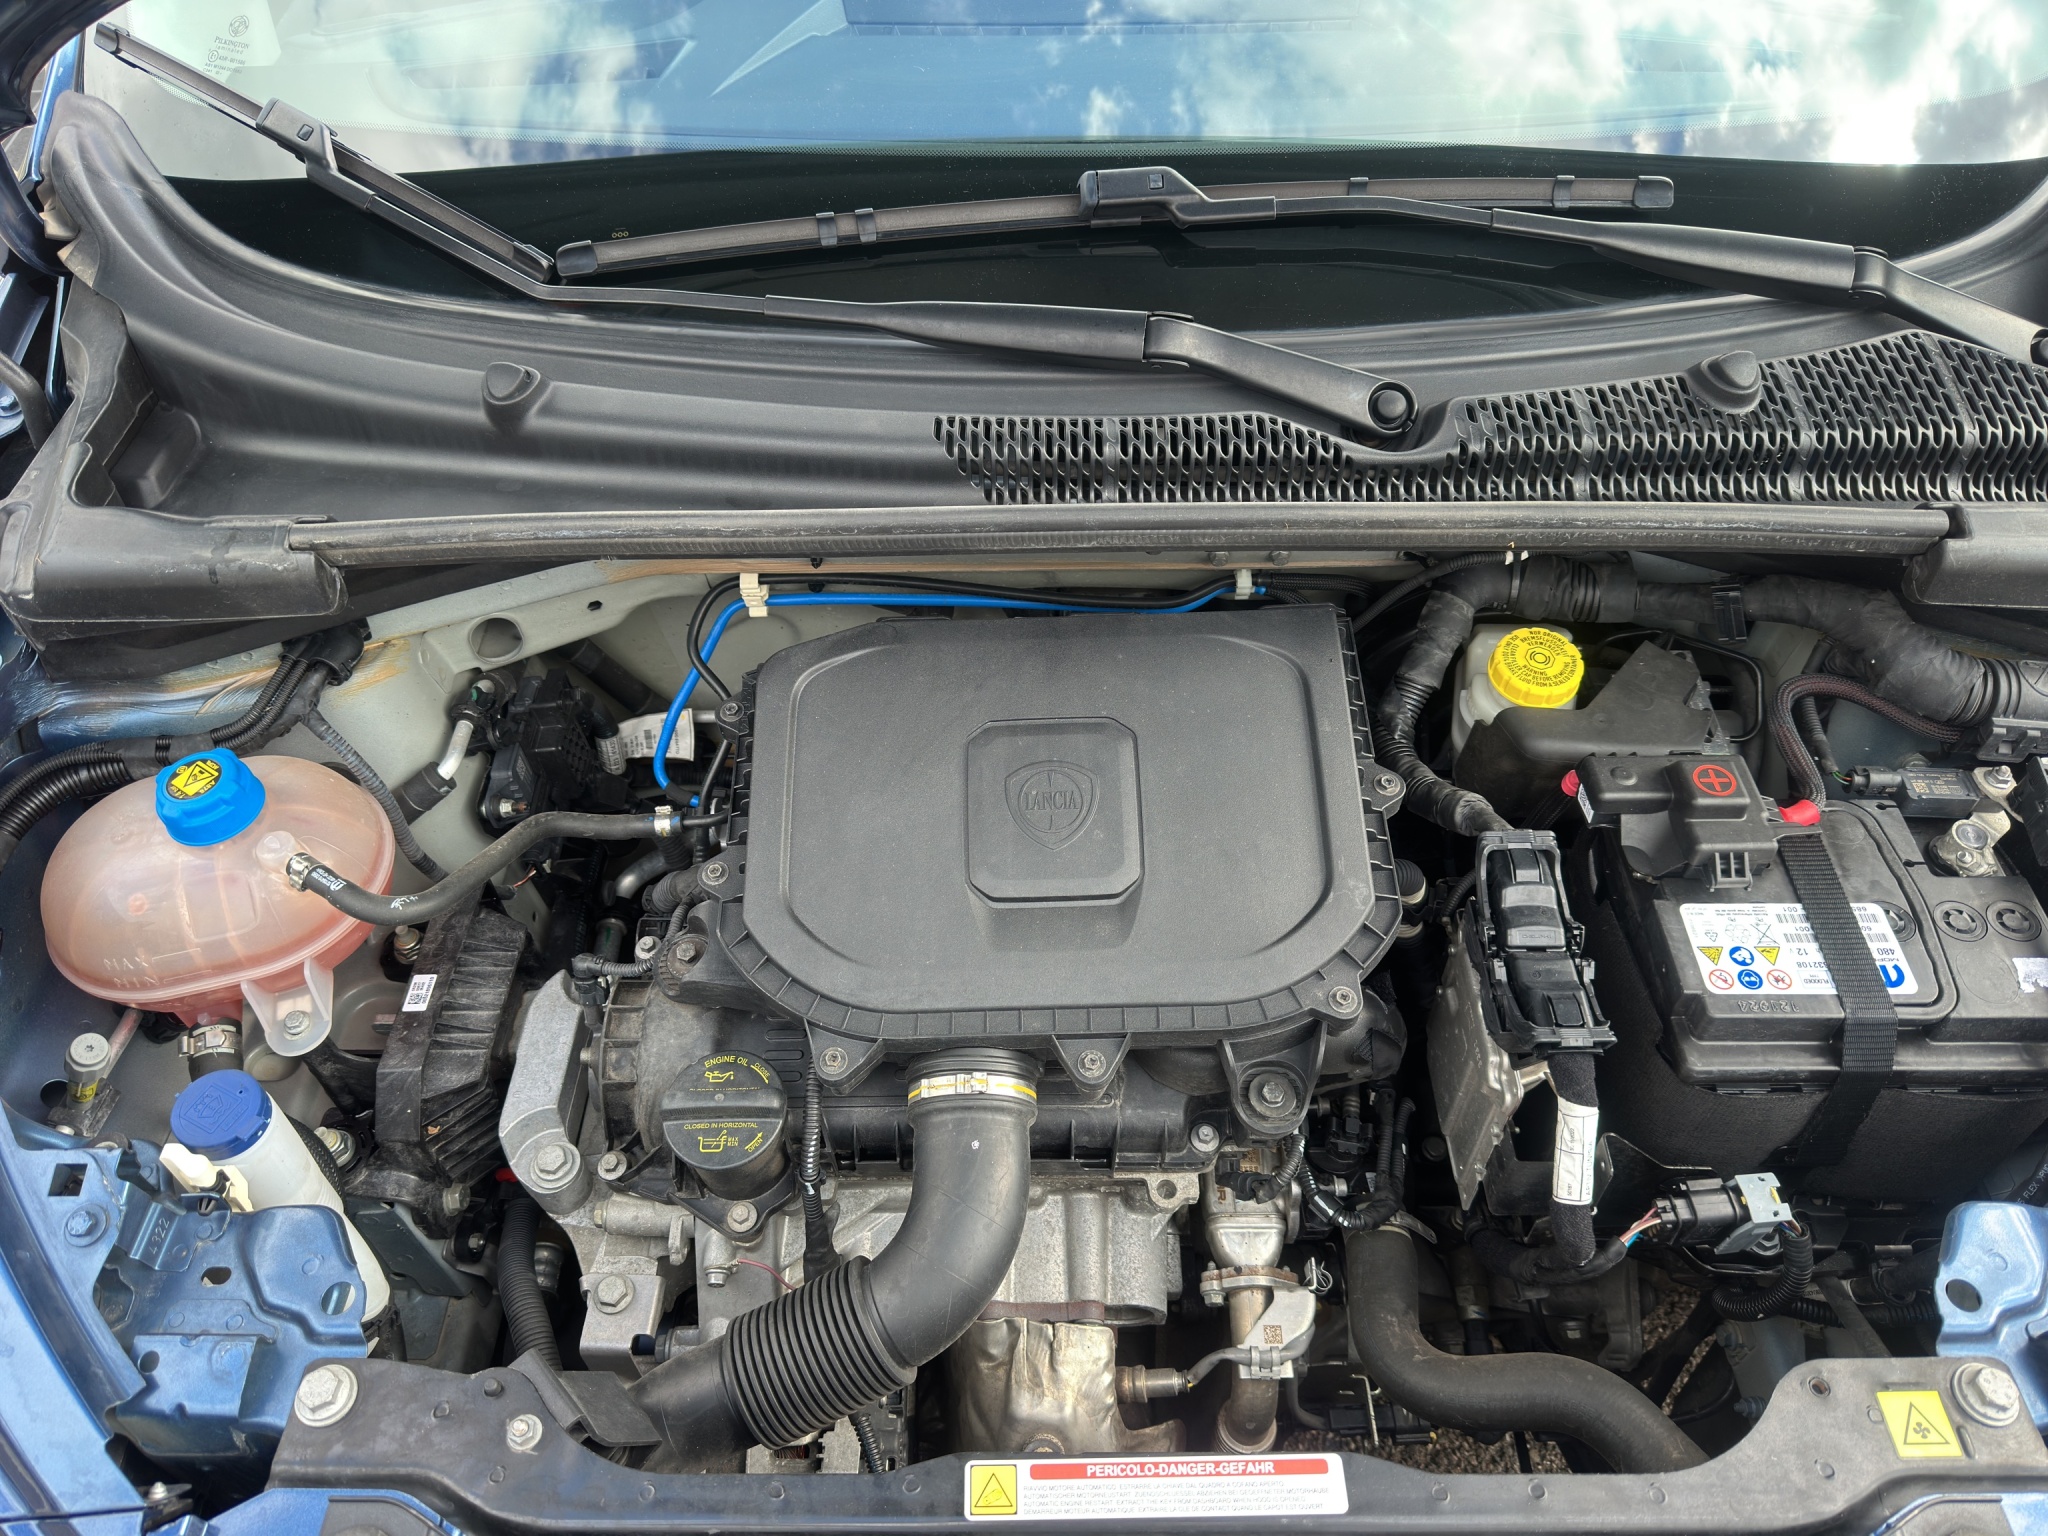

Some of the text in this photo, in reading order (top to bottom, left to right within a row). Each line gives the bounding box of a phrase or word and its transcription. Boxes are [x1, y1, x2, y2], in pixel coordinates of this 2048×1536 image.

[214, 36, 249, 49] PILKINGTON
[216, 44, 244, 54] laminated
[1542, 631, 1568, 646] ORIGINAL
[1504, 662, 1518, 676] BRAKE
[1516, 674, 1532, 684] FLUID
[1552, 676, 1570, 686] SEALED
[1567, 654, 1578, 678] CONTAINER
[1522, 664, 1548, 676] WARNING
[1553, 661, 1570, 679] REMOVING
[1024, 790, 1080, 810] LANCIA
[1796, 948, 1808, 956] 12
[1876, 948, 1896, 956] 480
[103, 956, 148, 970] MAX
[114, 975, 160, 988] MIN
[704, 1056, 748, 1068] ENGINE OIL
[754, 1062, 770, 1078] CLOSE
[747, 1138, 762, 1152] OPEN
[2022, 1182, 2040, 1200] FLEX
[1086, 1462, 1275, 1477] PERICOLO-DANGER-GEFAHR
